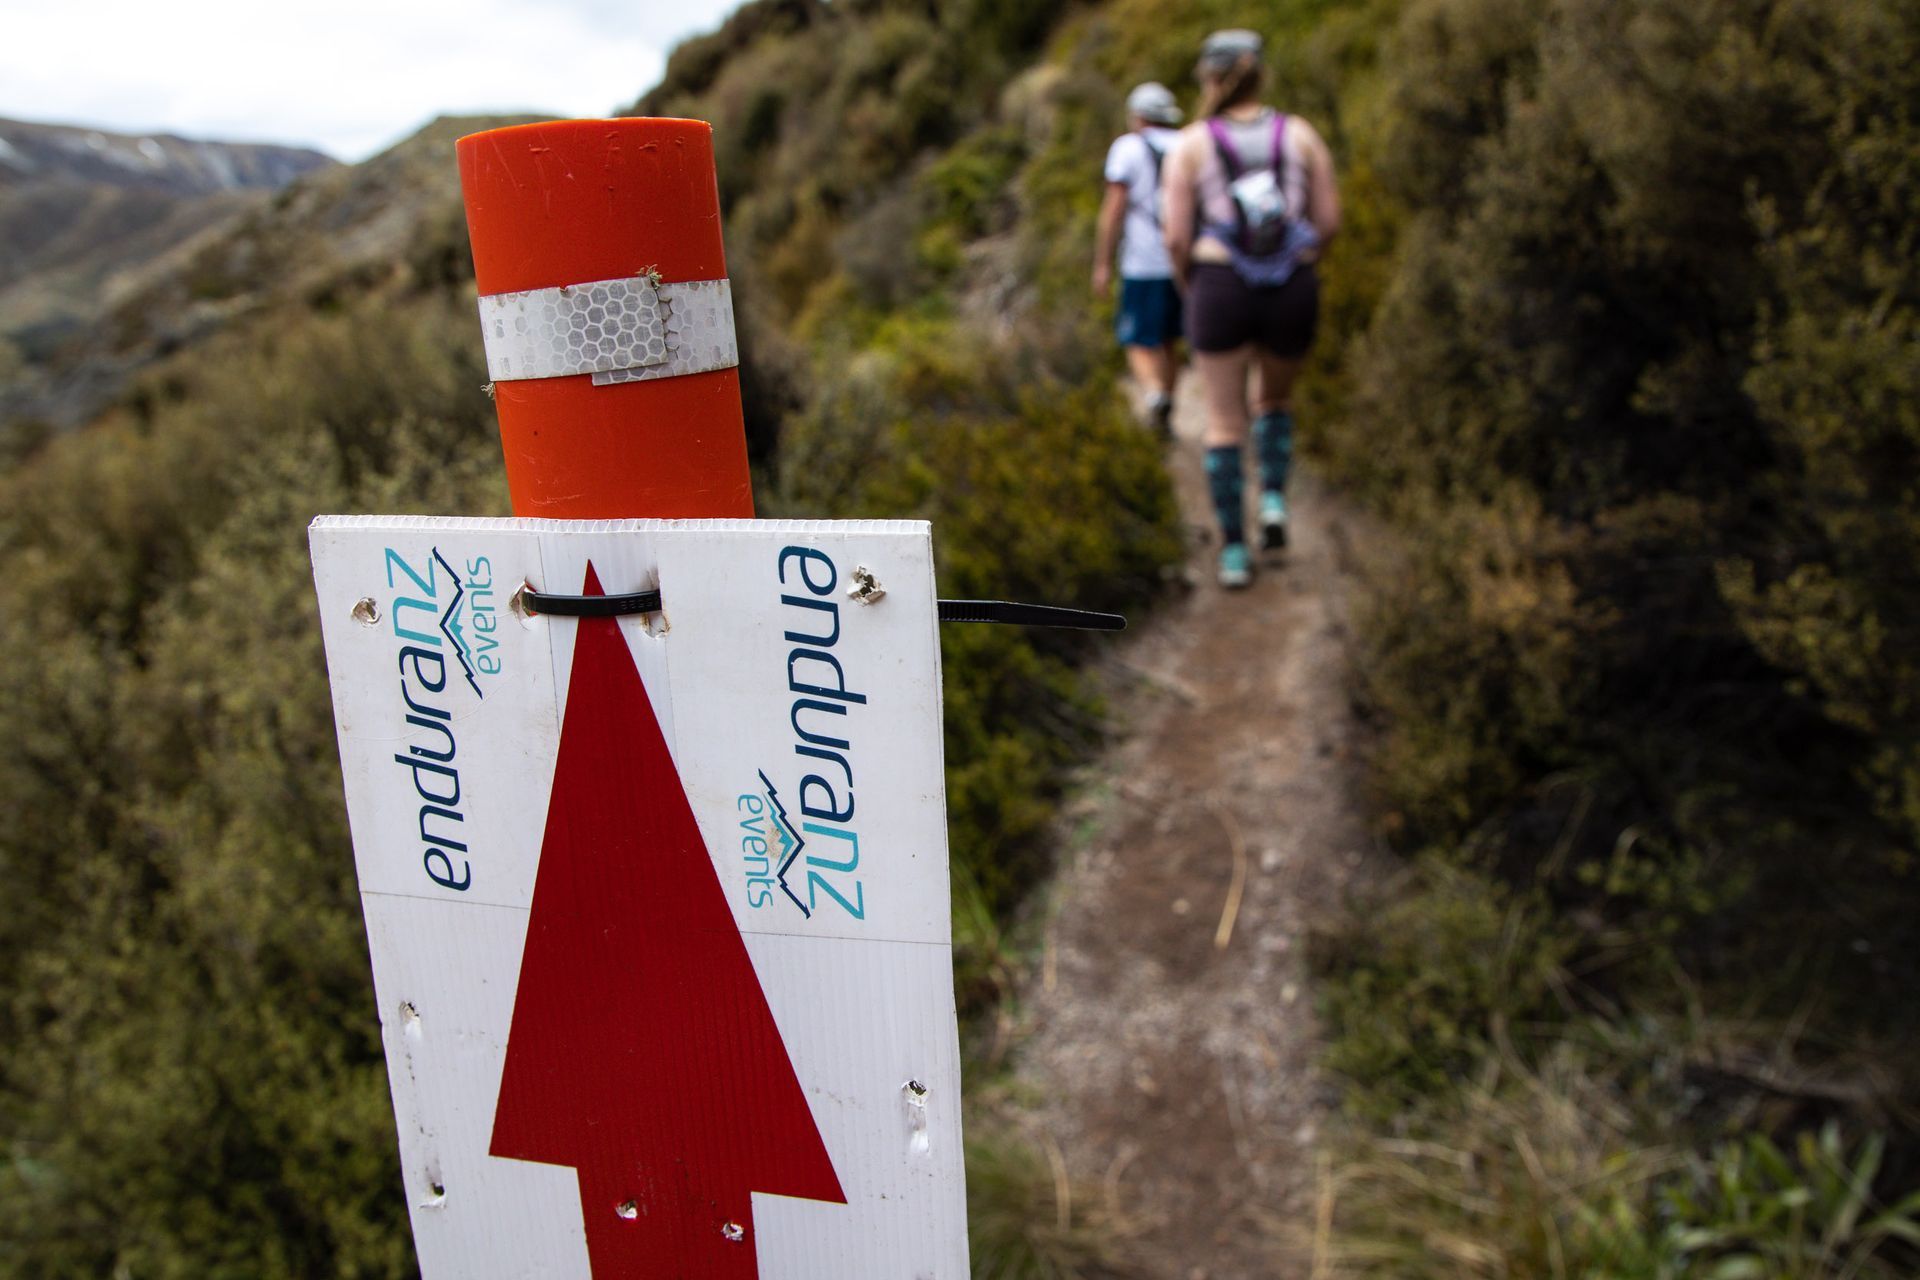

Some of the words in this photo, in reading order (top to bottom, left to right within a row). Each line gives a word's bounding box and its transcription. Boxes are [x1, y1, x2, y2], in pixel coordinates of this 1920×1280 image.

[383, 546, 471, 893] enduranz
[465, 555, 502, 676] events
[778, 544, 868, 921] enduranz
[737, 793, 776, 910] events
